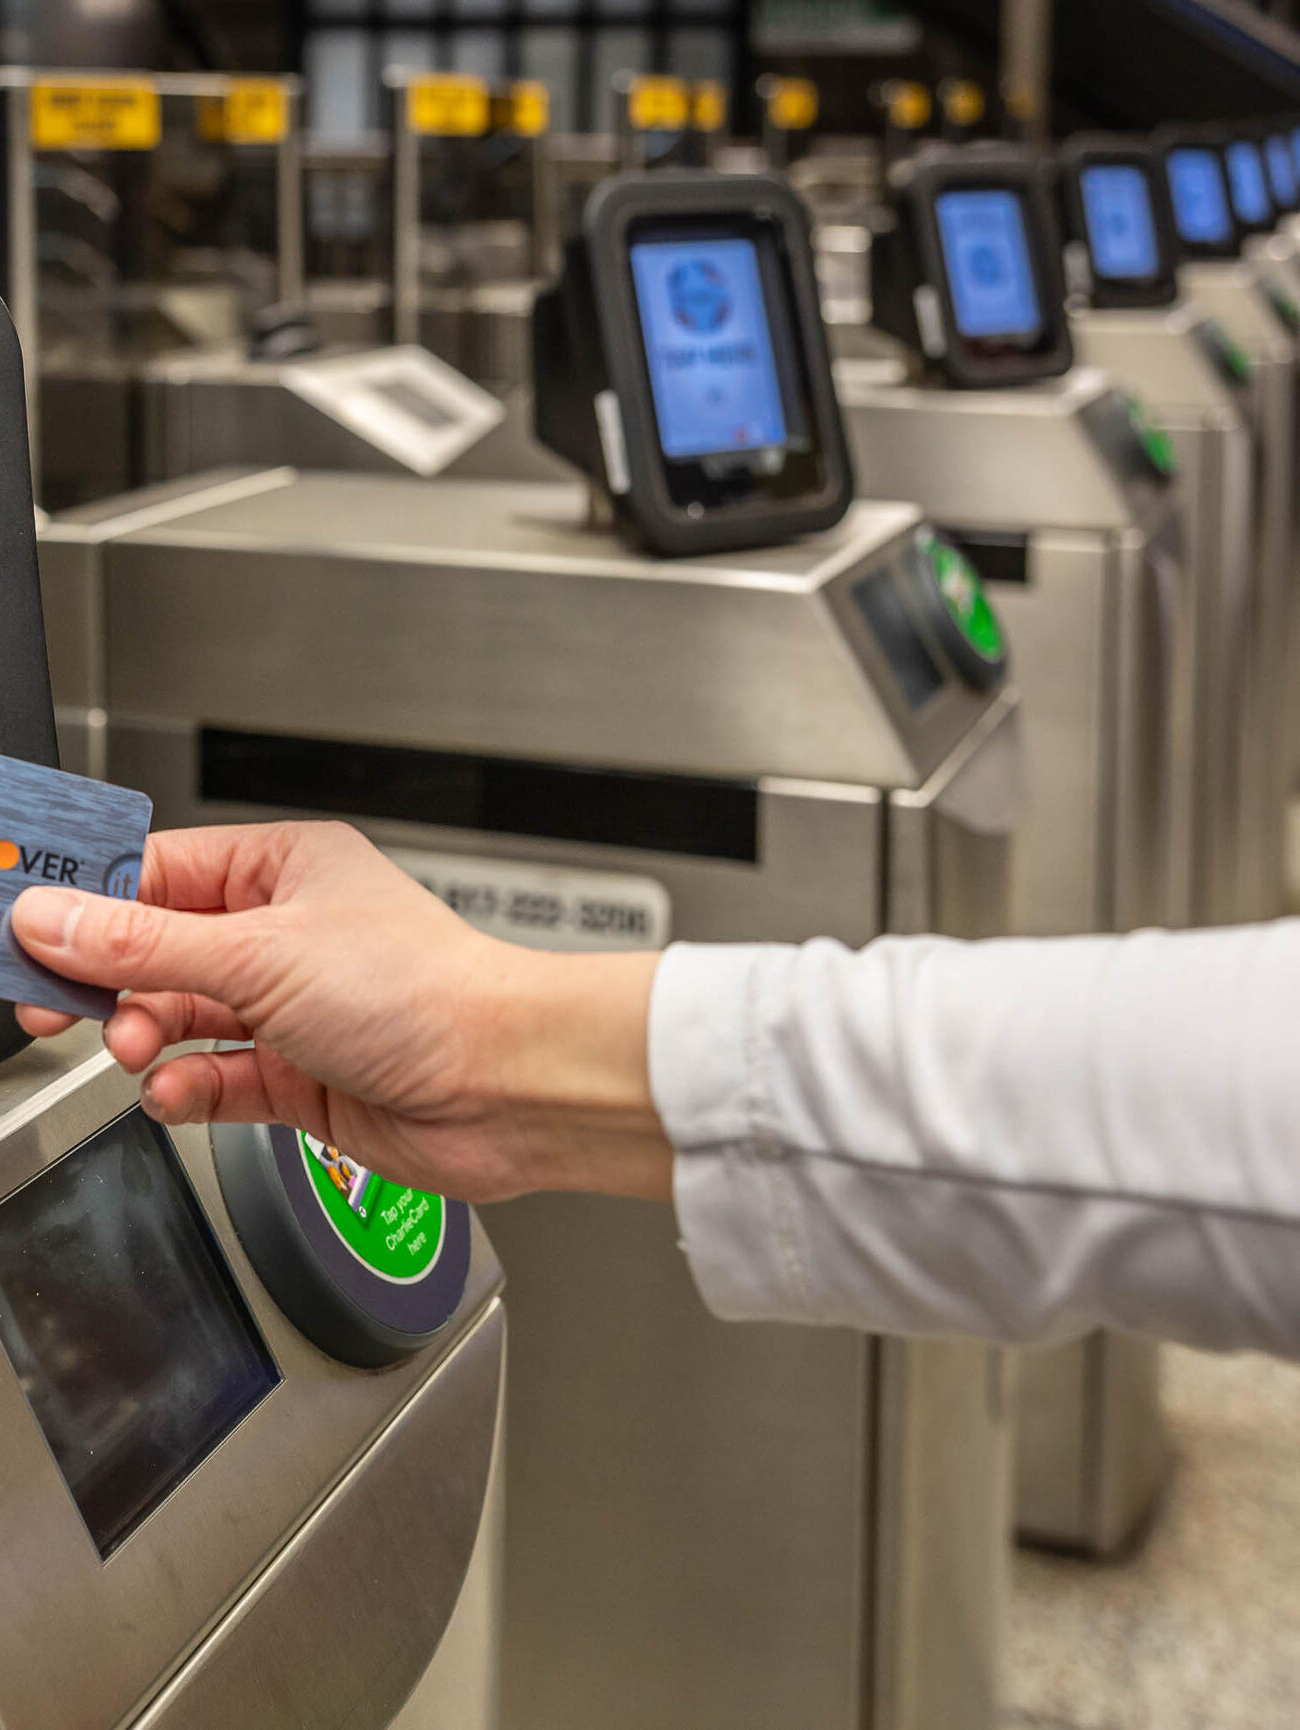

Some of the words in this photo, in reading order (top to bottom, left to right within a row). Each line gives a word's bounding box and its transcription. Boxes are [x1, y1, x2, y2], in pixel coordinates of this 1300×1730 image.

[380, 1206, 398, 1225] Tap
[385, 1196, 429, 1251] CharlieCard
[407, 1232, 427, 1256] here
